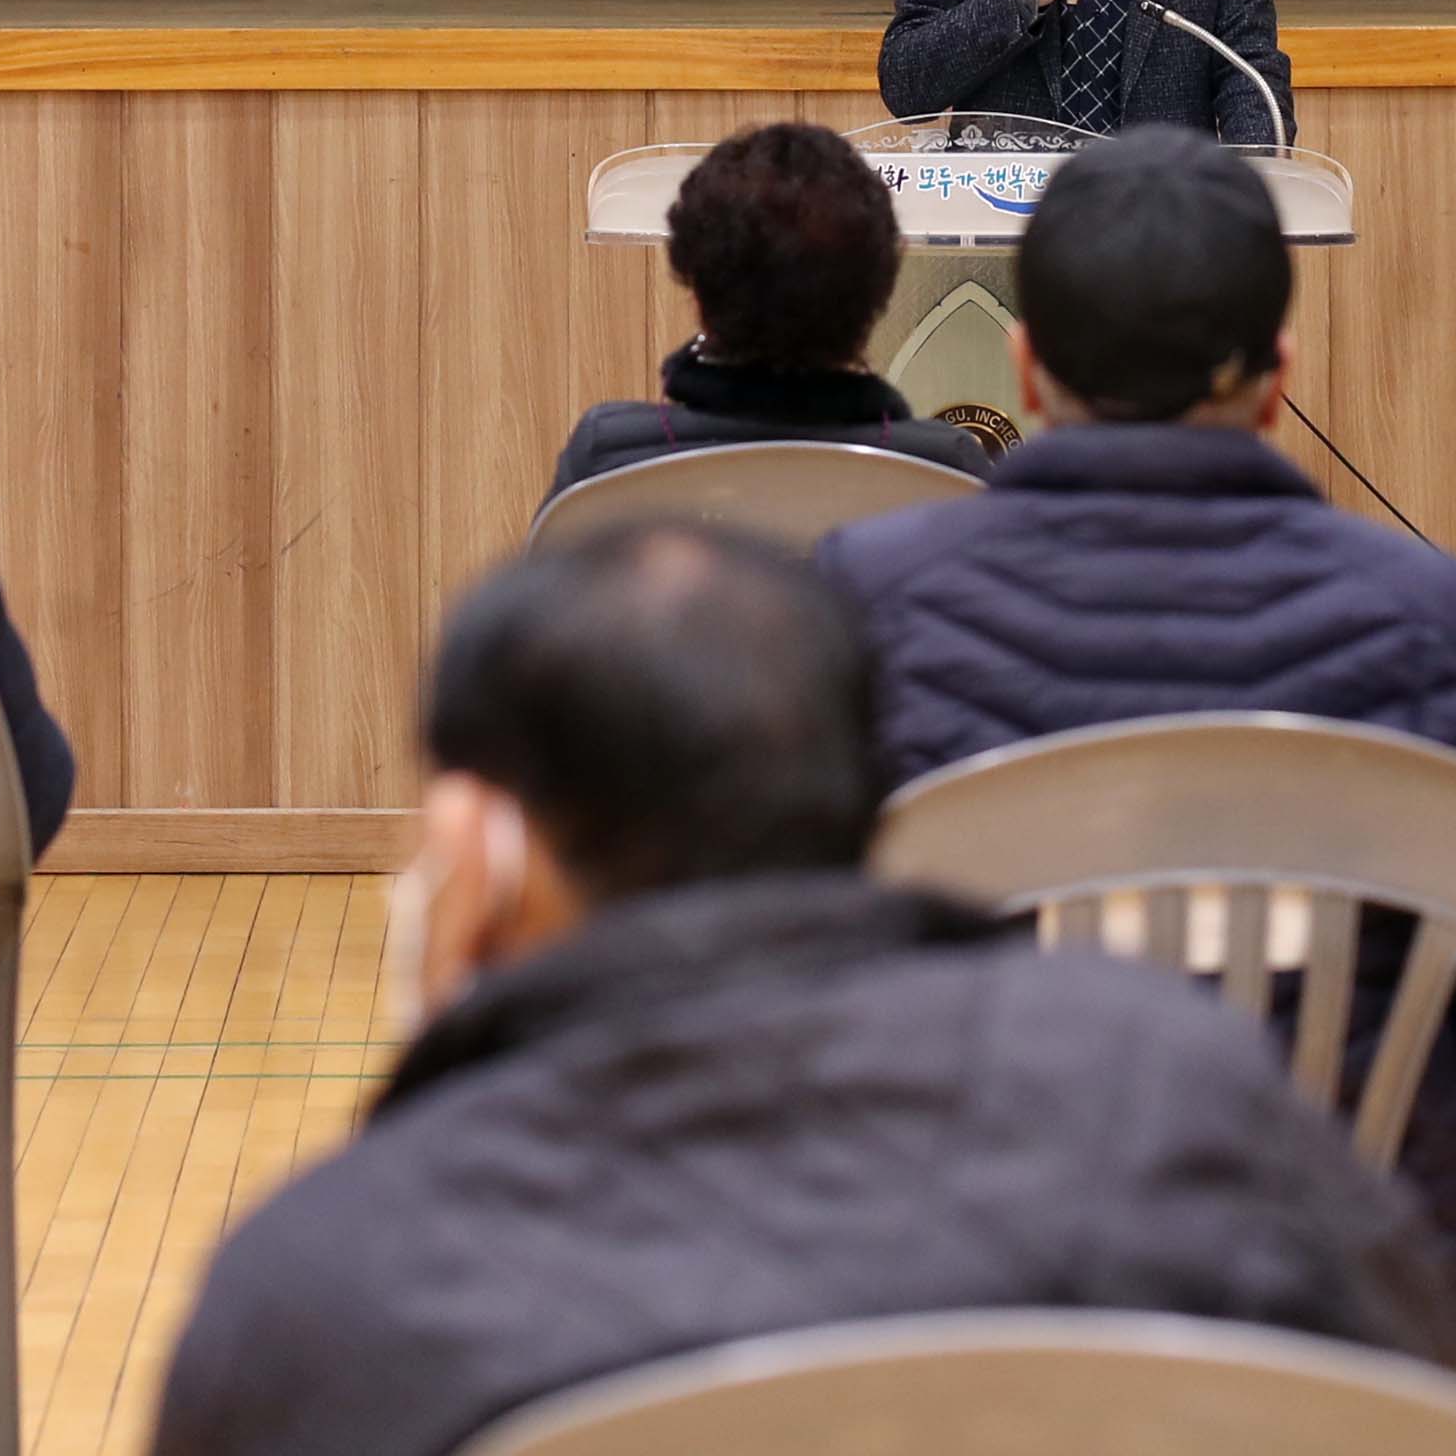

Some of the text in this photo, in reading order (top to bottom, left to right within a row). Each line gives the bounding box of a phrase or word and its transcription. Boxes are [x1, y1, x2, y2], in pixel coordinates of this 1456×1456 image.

[918, 166, 976, 198] 모두가
[984, 164, 1048, 198] 행복한
[975, 409, 1020, 449] INCHEO
